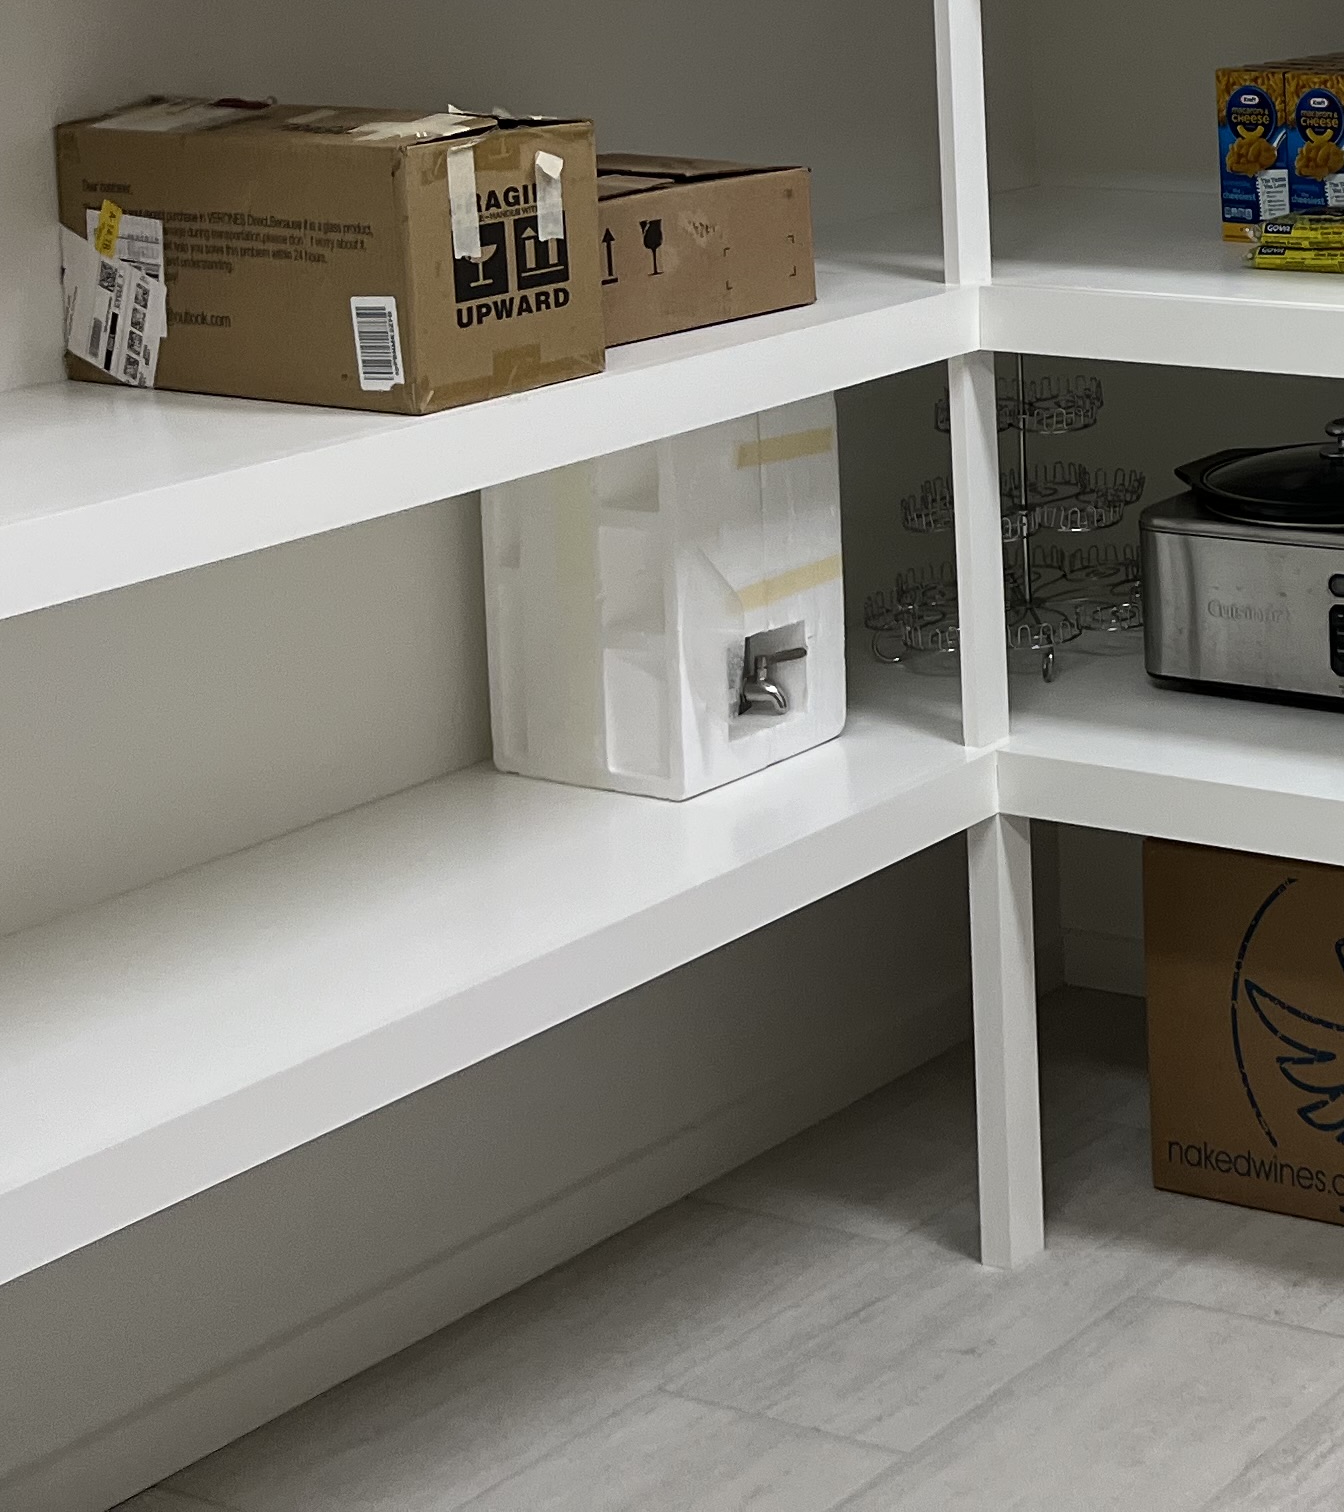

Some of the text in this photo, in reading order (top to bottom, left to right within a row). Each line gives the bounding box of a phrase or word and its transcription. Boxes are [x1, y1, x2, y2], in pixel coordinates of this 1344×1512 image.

[166, 211, 198, 226] purchase
[323, 220, 340, 235] glass
[343, 222, 374, 238] product,
[456, 288, 571, 329] UPWARD
